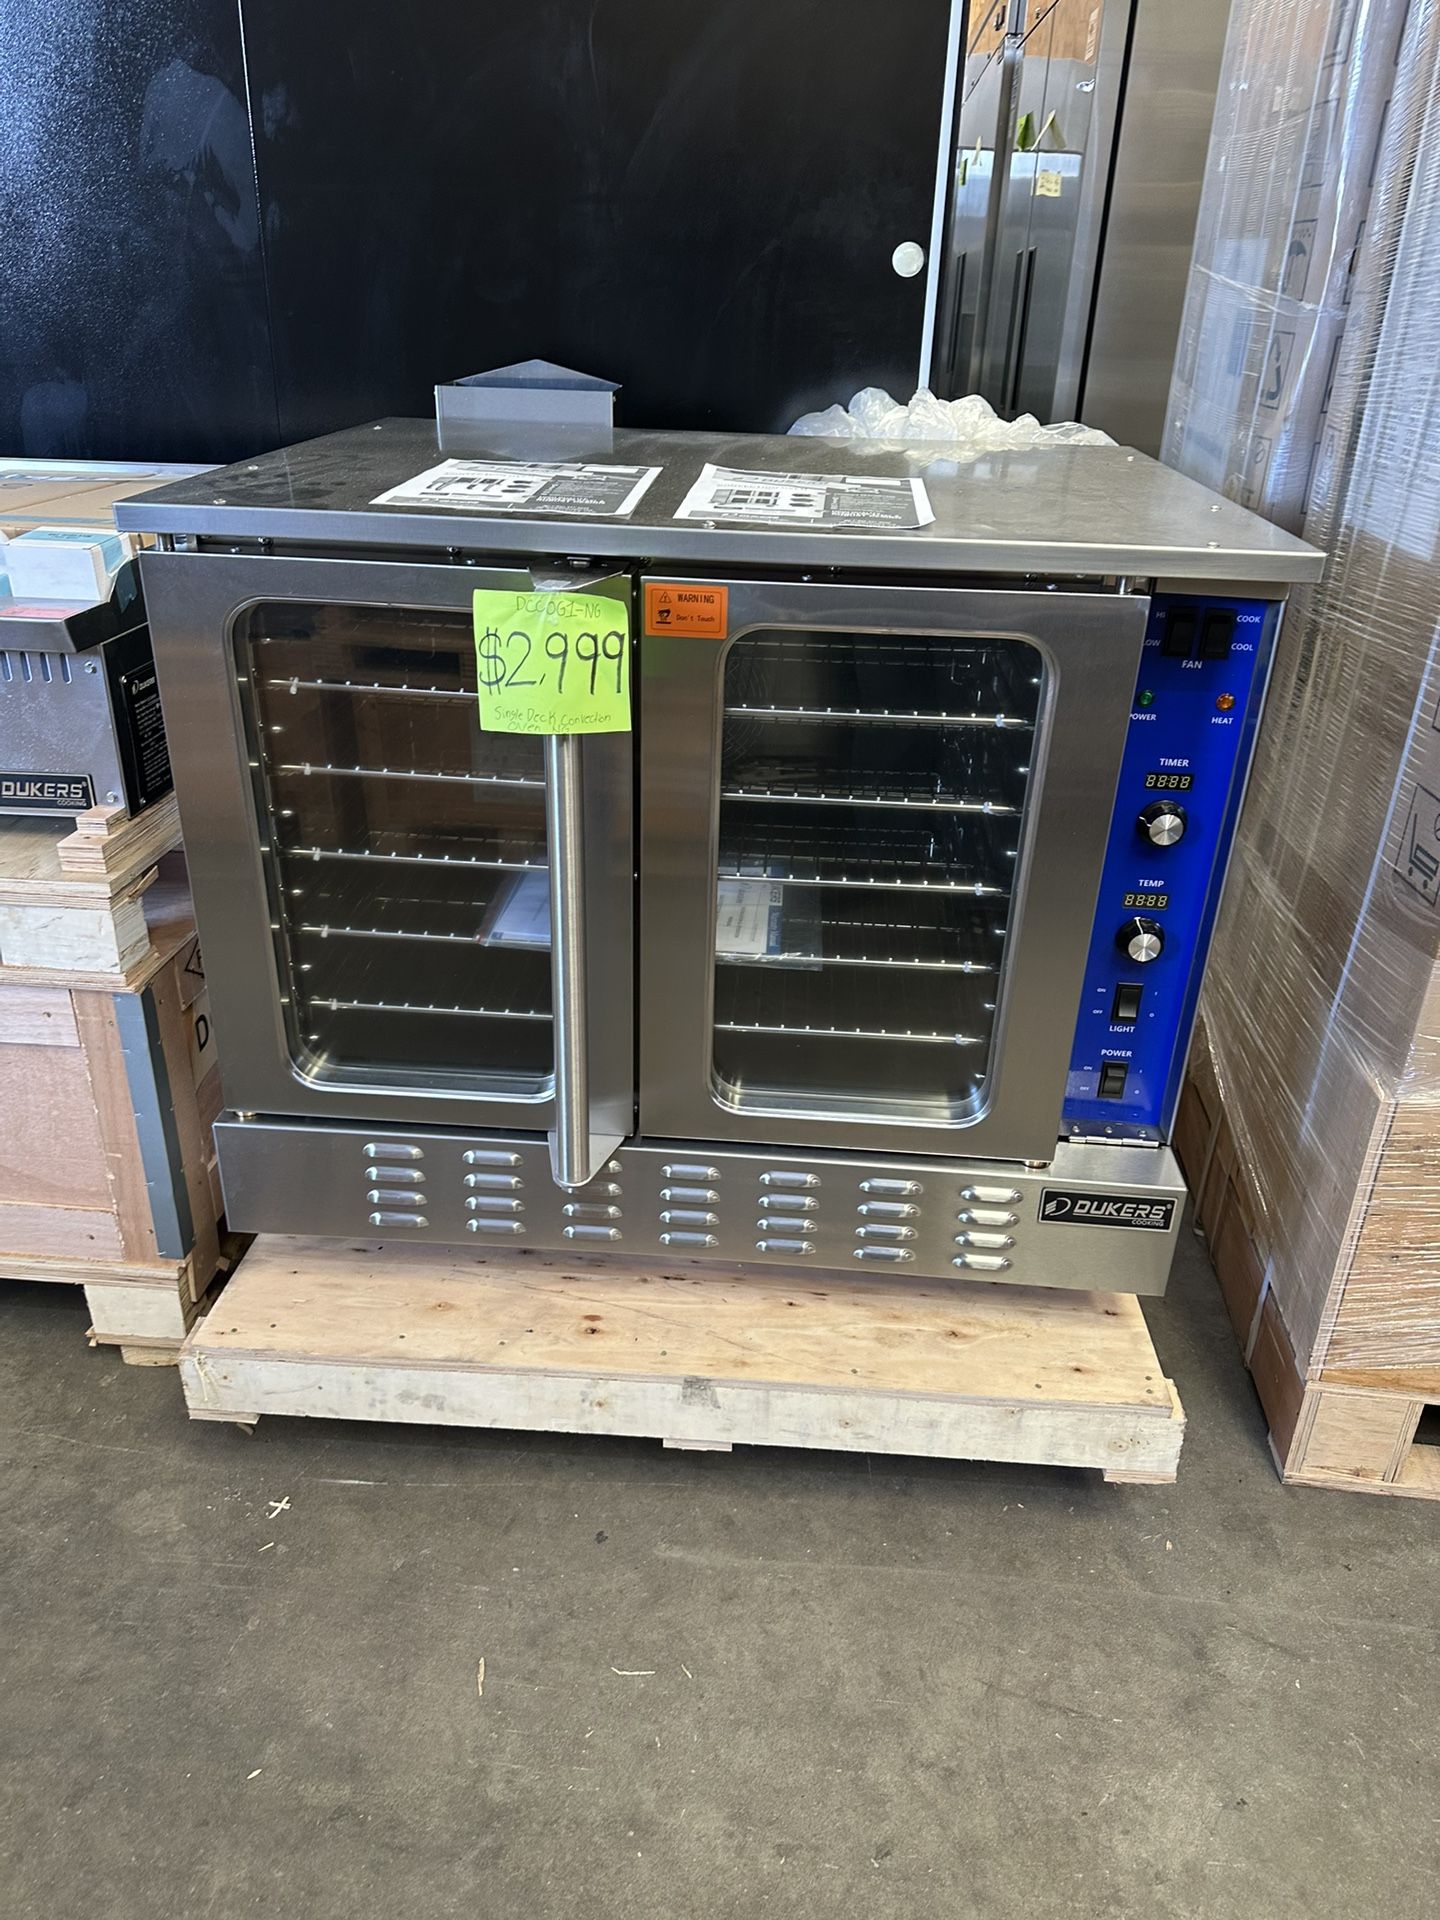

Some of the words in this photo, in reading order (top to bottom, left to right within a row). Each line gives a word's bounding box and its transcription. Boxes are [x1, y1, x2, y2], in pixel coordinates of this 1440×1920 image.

[677, 593, 715, 604] WARNING
[676, 613, 694, 622] Don't
[697, 615, 715, 623] Touch
[1236, 615, 1261, 624] COOK
[1231, 643, 1253, 651] COOL
[478, 626, 626, 696] $2,999
[1181, 660, 1202, 669] FAN
[494, 705, 522, 721] Single
[1211, 716, 1234, 725] HEAT
[1159, 757, 1189, 768] TIMER
[1, 781, 83, 798] DUKERS
[1138, 879, 1164, 888] TEMP
[1109, 1025, 1136, 1034] LIGHT
[1101, 1049, 1133, 1058] POWER
[1073, 1200, 1166, 1219] DUKERS
[1131, 1218, 1165, 1227] COOKING
